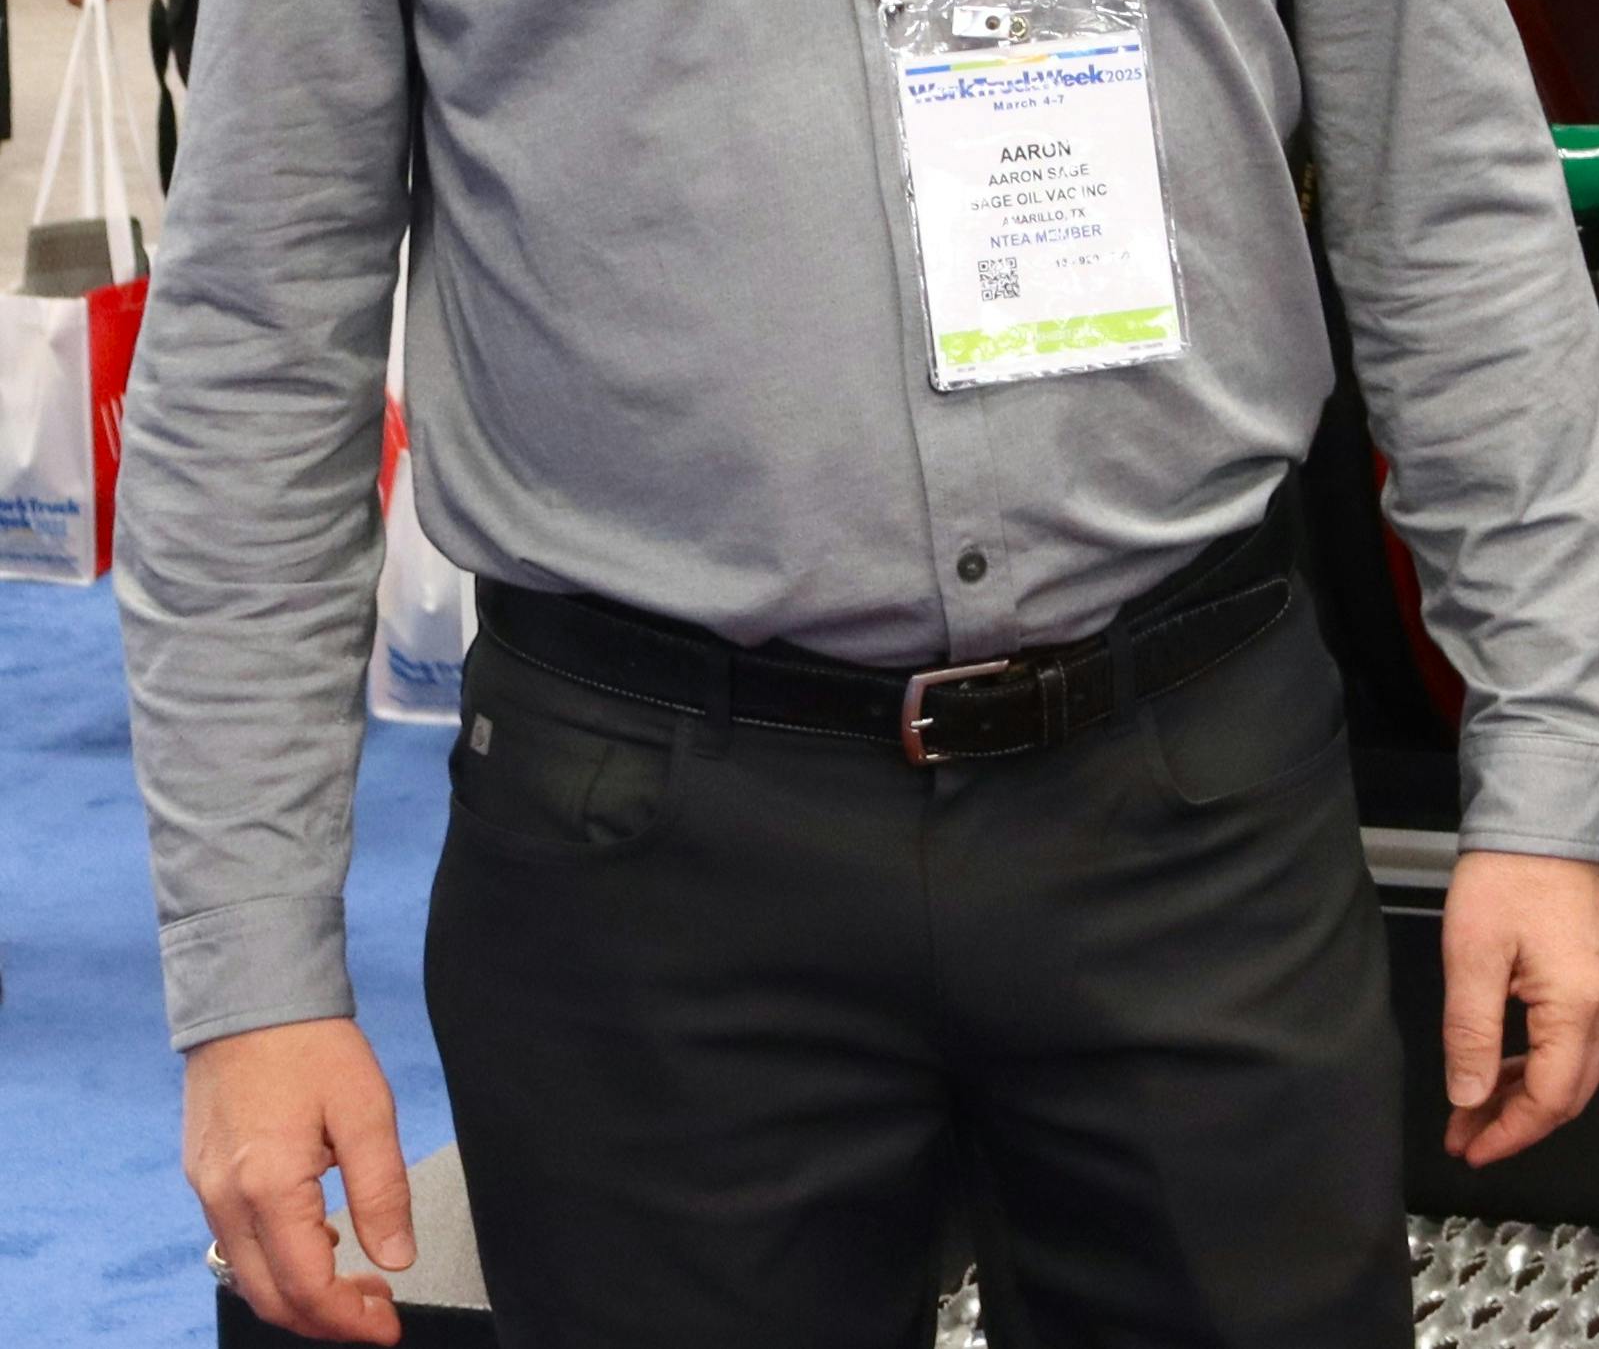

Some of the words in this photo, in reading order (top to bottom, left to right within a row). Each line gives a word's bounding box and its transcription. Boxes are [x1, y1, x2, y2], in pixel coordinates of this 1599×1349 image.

[1106, 68, 1143, 84] 2025
[993, 98, 1037, 112] March
[1043, 95, 1065, 106] 4-7
[1000, 140, 1073, 164] AARON
[988, 169, 1043, 187] AARON
[1047, 163, 1090, 180] SAGE
[971, 194, 1013, 211] SAGE
[1016, 191, 1043, 206] OIL
[1045, 187, 1078, 203] VAC
[1081, 183, 1108, 198] INC
[1071, 208, 1087, 219] TX
[990, 233, 1032, 249] NTEA
[1036, 224, 1103, 244] MEMBER
